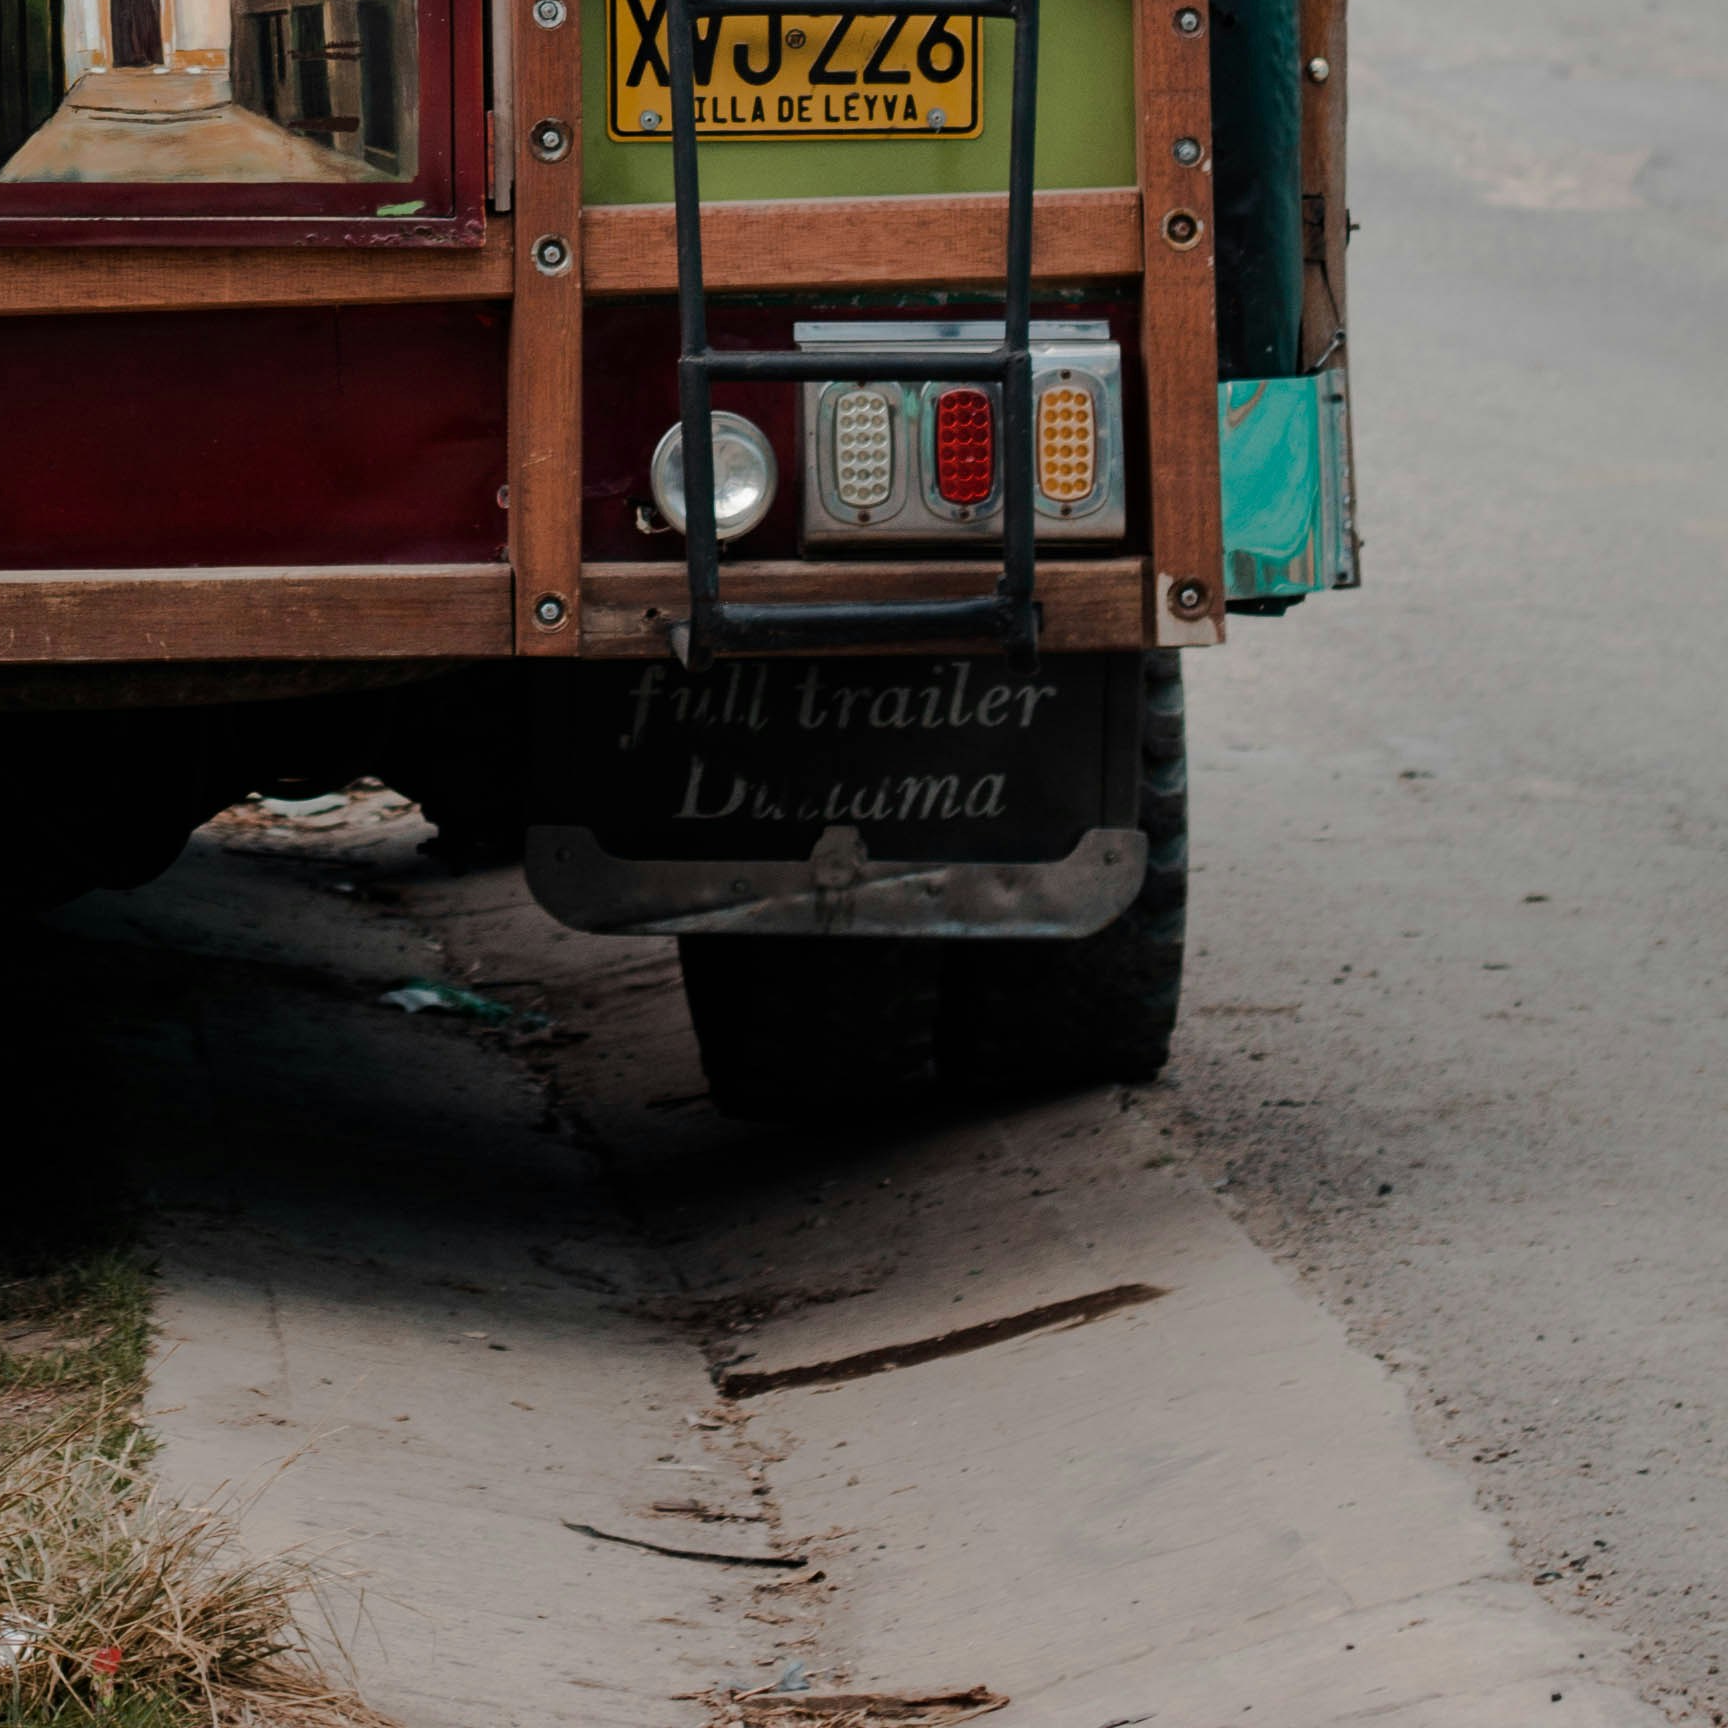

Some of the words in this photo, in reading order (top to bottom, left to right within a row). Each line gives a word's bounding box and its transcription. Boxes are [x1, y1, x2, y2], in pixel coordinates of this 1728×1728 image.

[694, 95, 766, 124] ILLA
[777, 94, 812, 123] DE
[824, 92, 918, 122] LEYVA
[618, 661, 769, 751] full
[794, 659, 1057, 729] trailer
